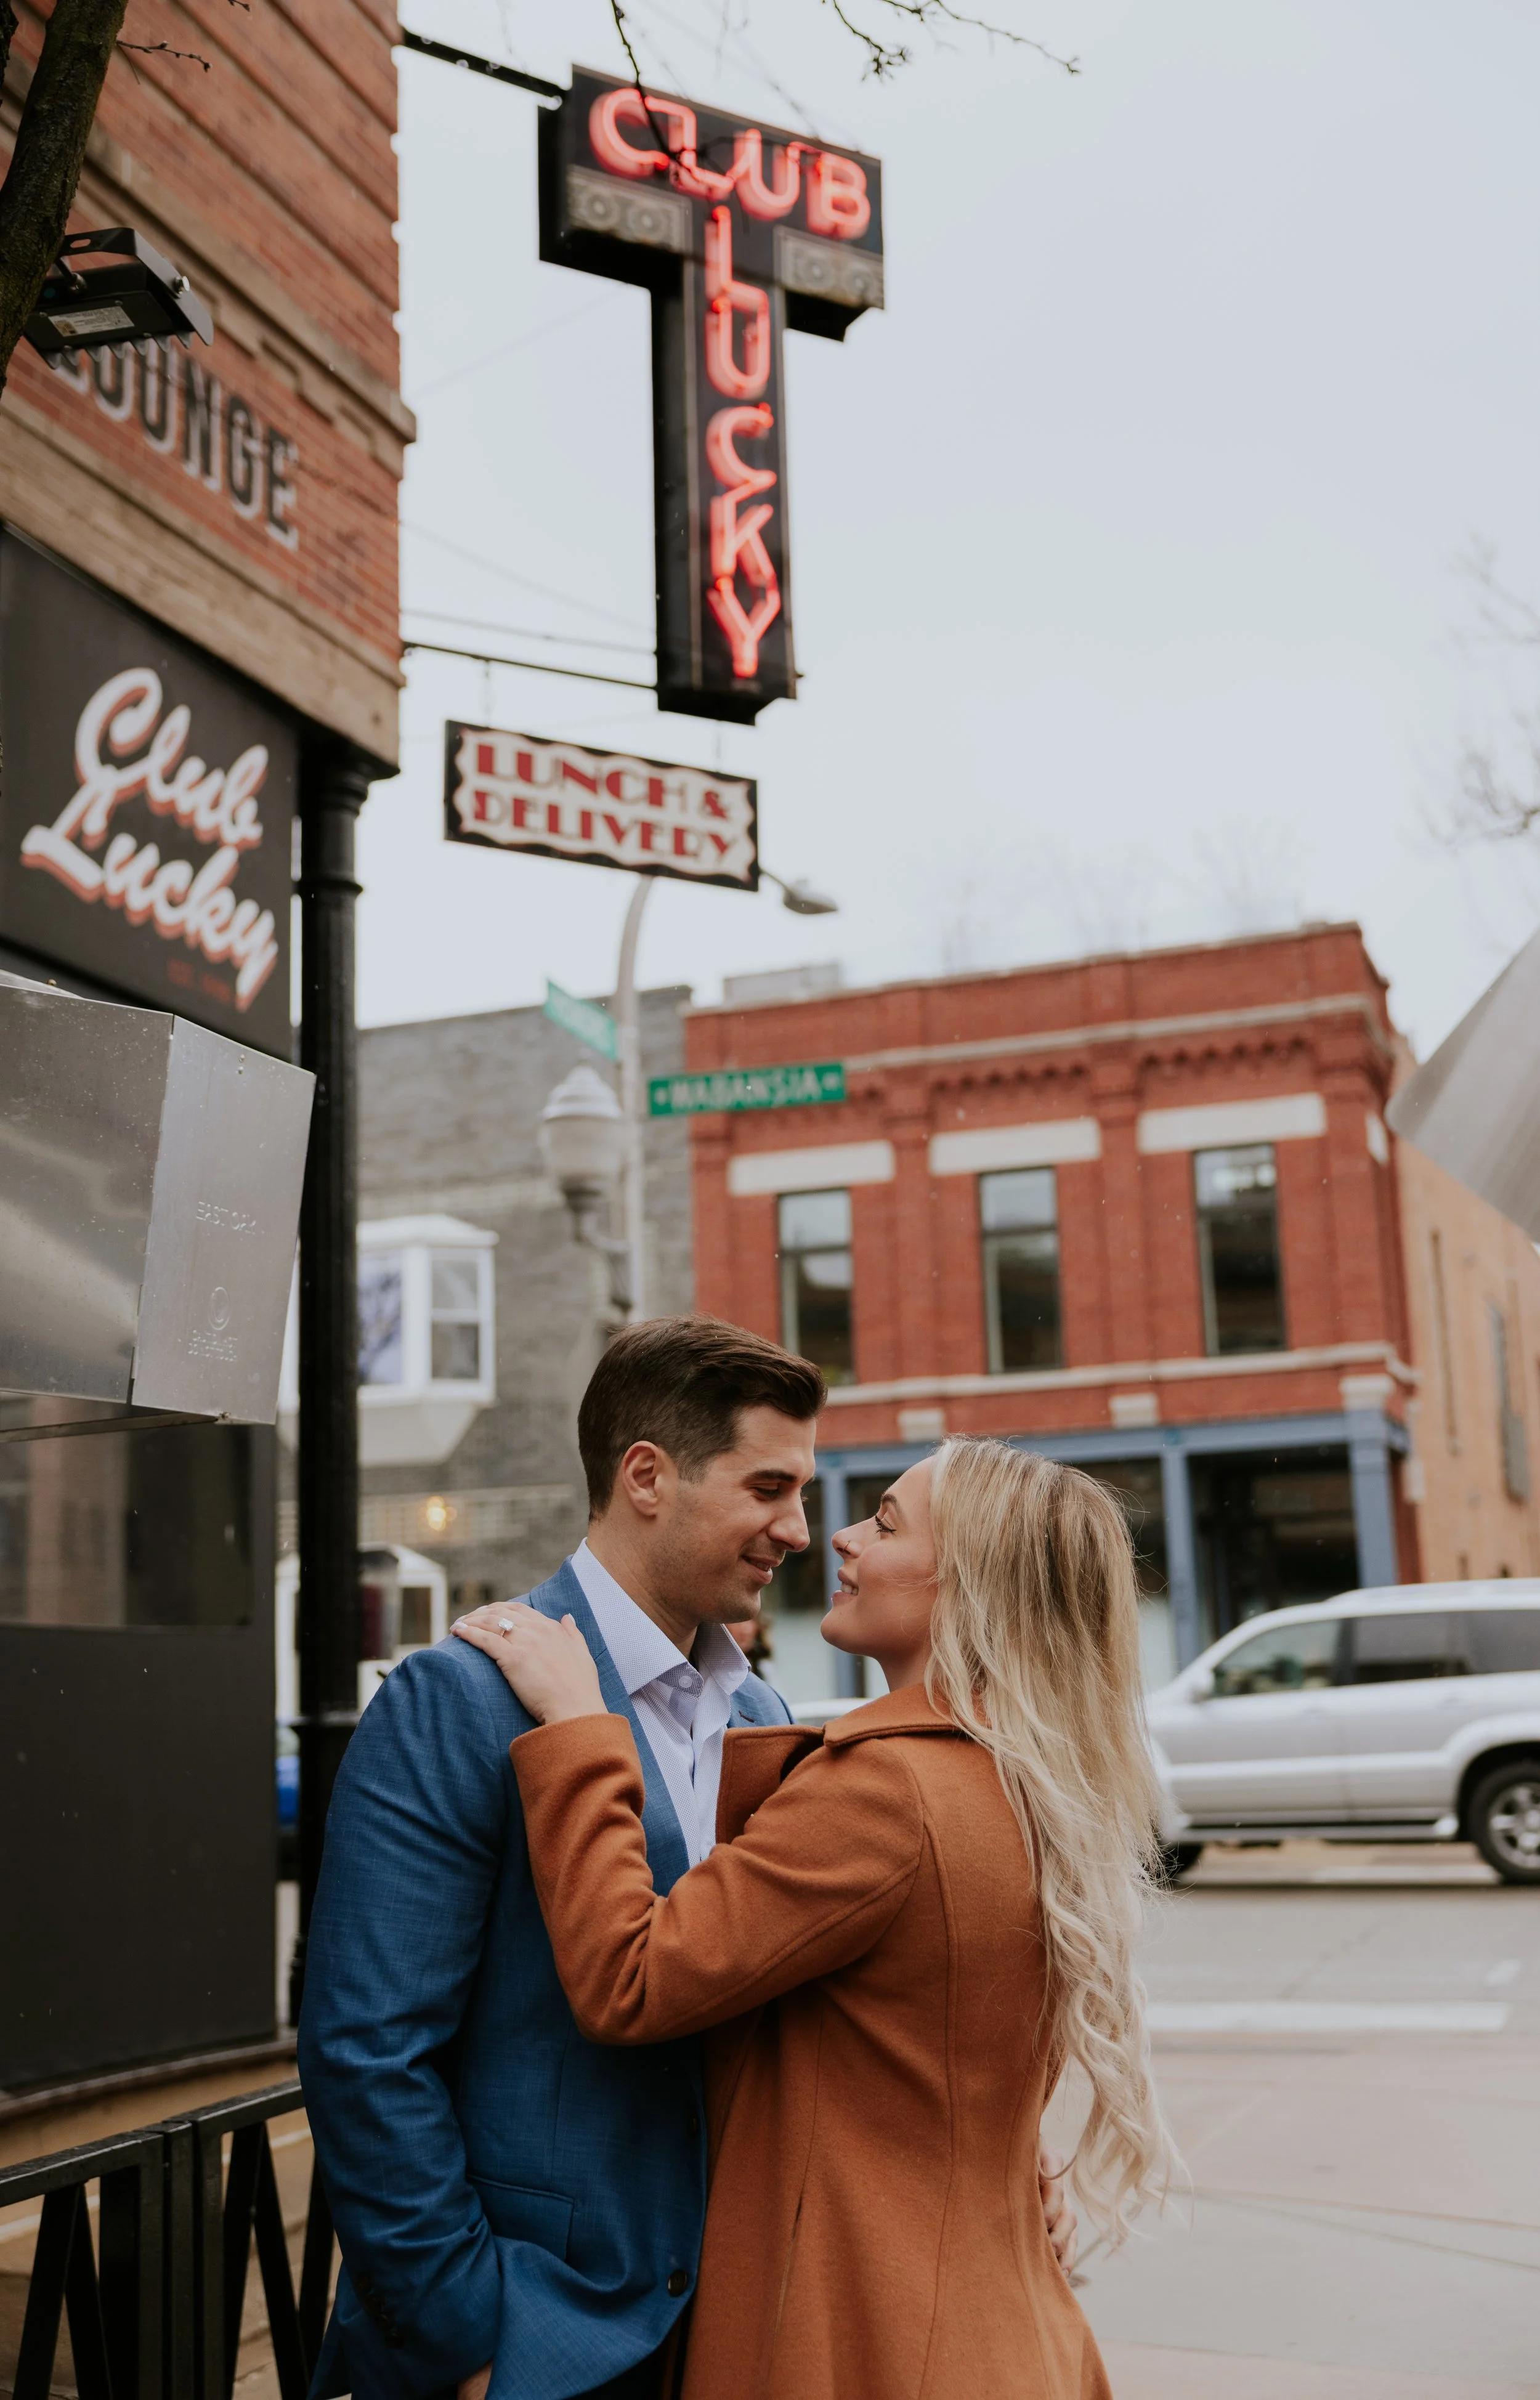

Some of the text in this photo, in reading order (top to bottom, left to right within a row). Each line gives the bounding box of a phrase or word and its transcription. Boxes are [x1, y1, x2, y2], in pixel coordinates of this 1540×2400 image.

[589, 87, 871, 240] CLUB
[704, 205, 781, 678] LUCKY
[75, 667, 269, 848] Club
[473, 789, 738, 865] DELIVERY
[476, 743, 733, 822] LUNCH &
[21, 765, 278, 1012] Lucky
